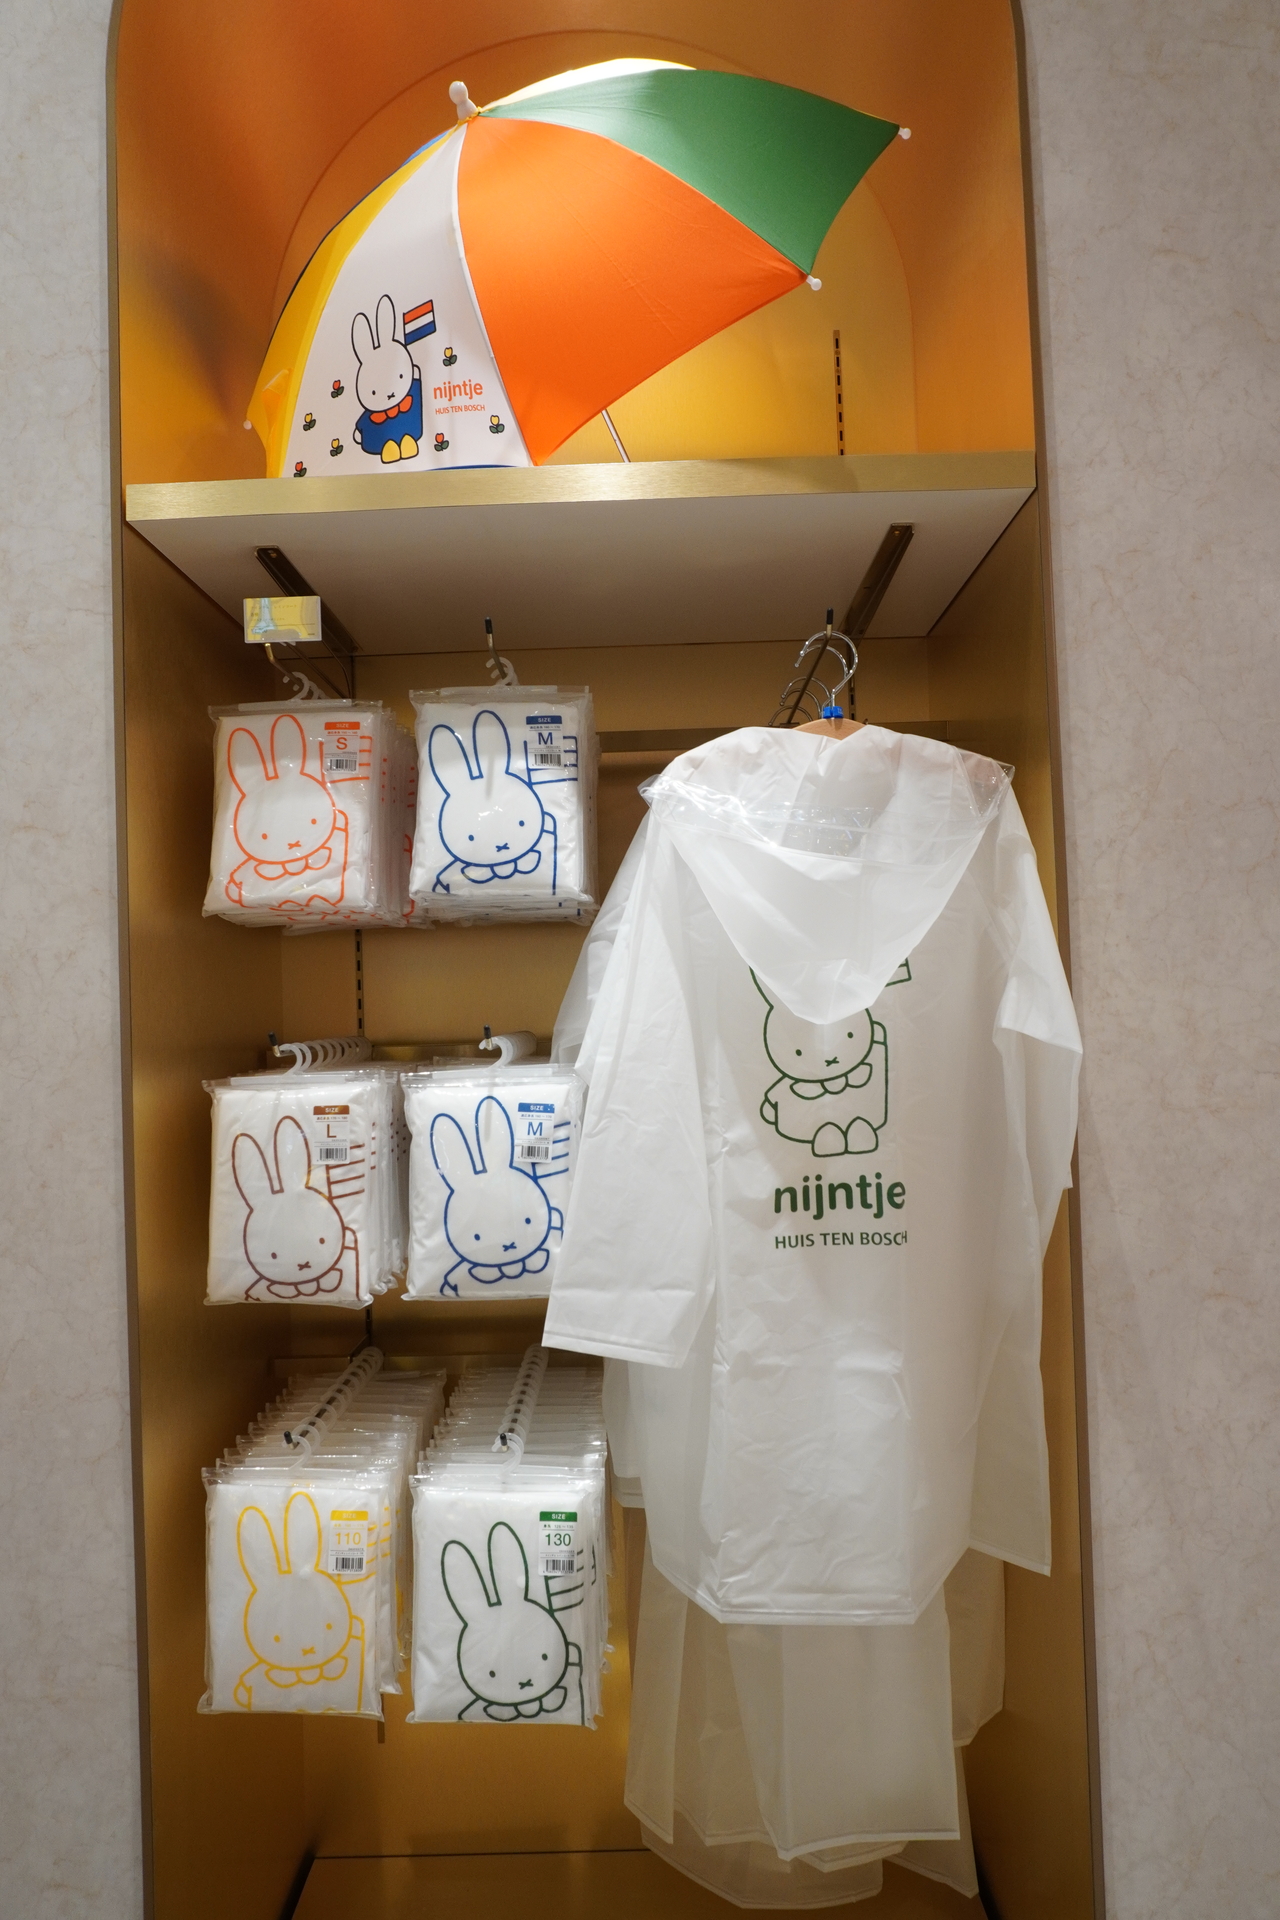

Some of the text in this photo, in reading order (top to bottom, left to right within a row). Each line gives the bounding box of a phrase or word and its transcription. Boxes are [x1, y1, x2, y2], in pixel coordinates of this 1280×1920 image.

[433, 379, 483, 401] nijntje
[435, 404, 486, 415] HUIS TEN BOSCH
[336, 737, 348, 750] S
[538, 732, 553, 745] M
[327, 1124, 337, 1138] L
[527, 1121, 543, 1136] M
[774, 1172, 906, 1220] nijntje
[775, 1230, 908, 1249] HUIS TEN BOSCH
[335, 1532, 362, 1545] 110
[545, 1533, 571, 1546] 130
